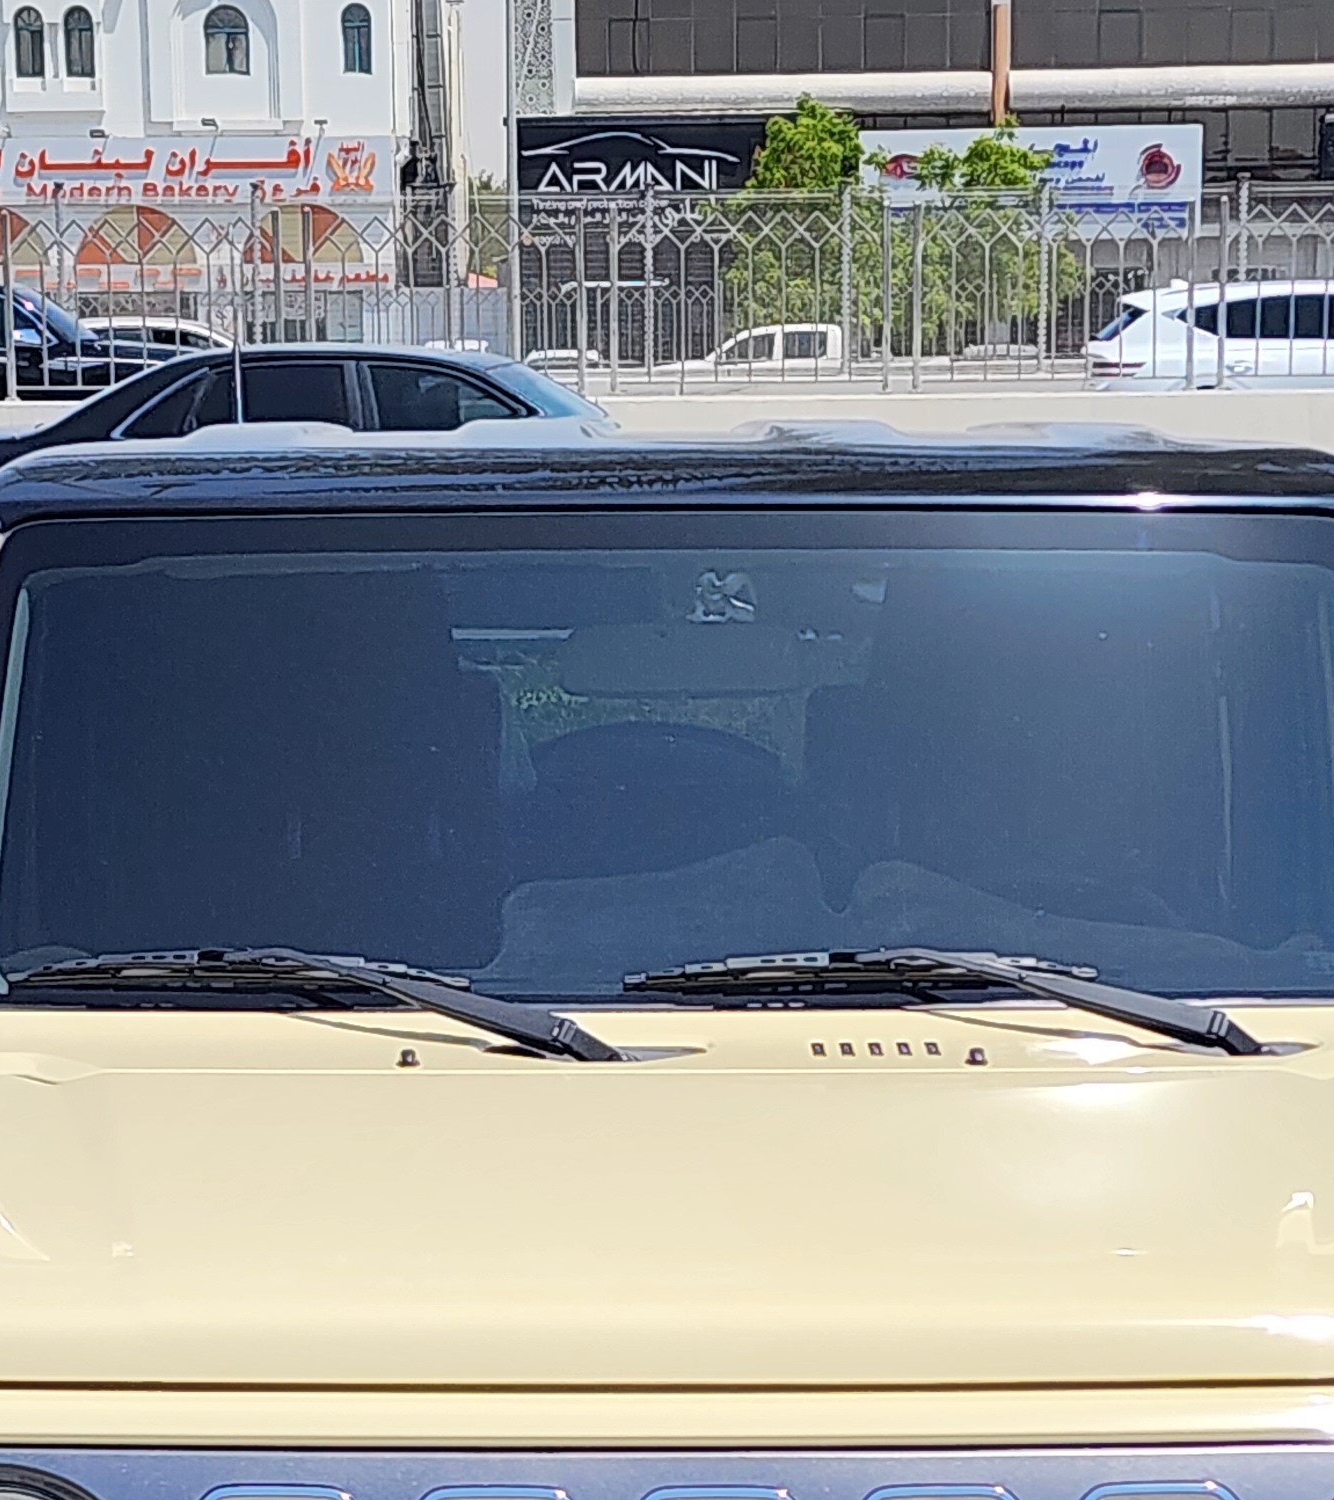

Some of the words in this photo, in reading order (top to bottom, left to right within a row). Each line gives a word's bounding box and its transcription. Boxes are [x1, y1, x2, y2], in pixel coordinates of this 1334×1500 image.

[537, 159, 717, 193] ARMANI
[25, 181, 133, 204] Modern
[141, 180, 240, 204] Bakery
